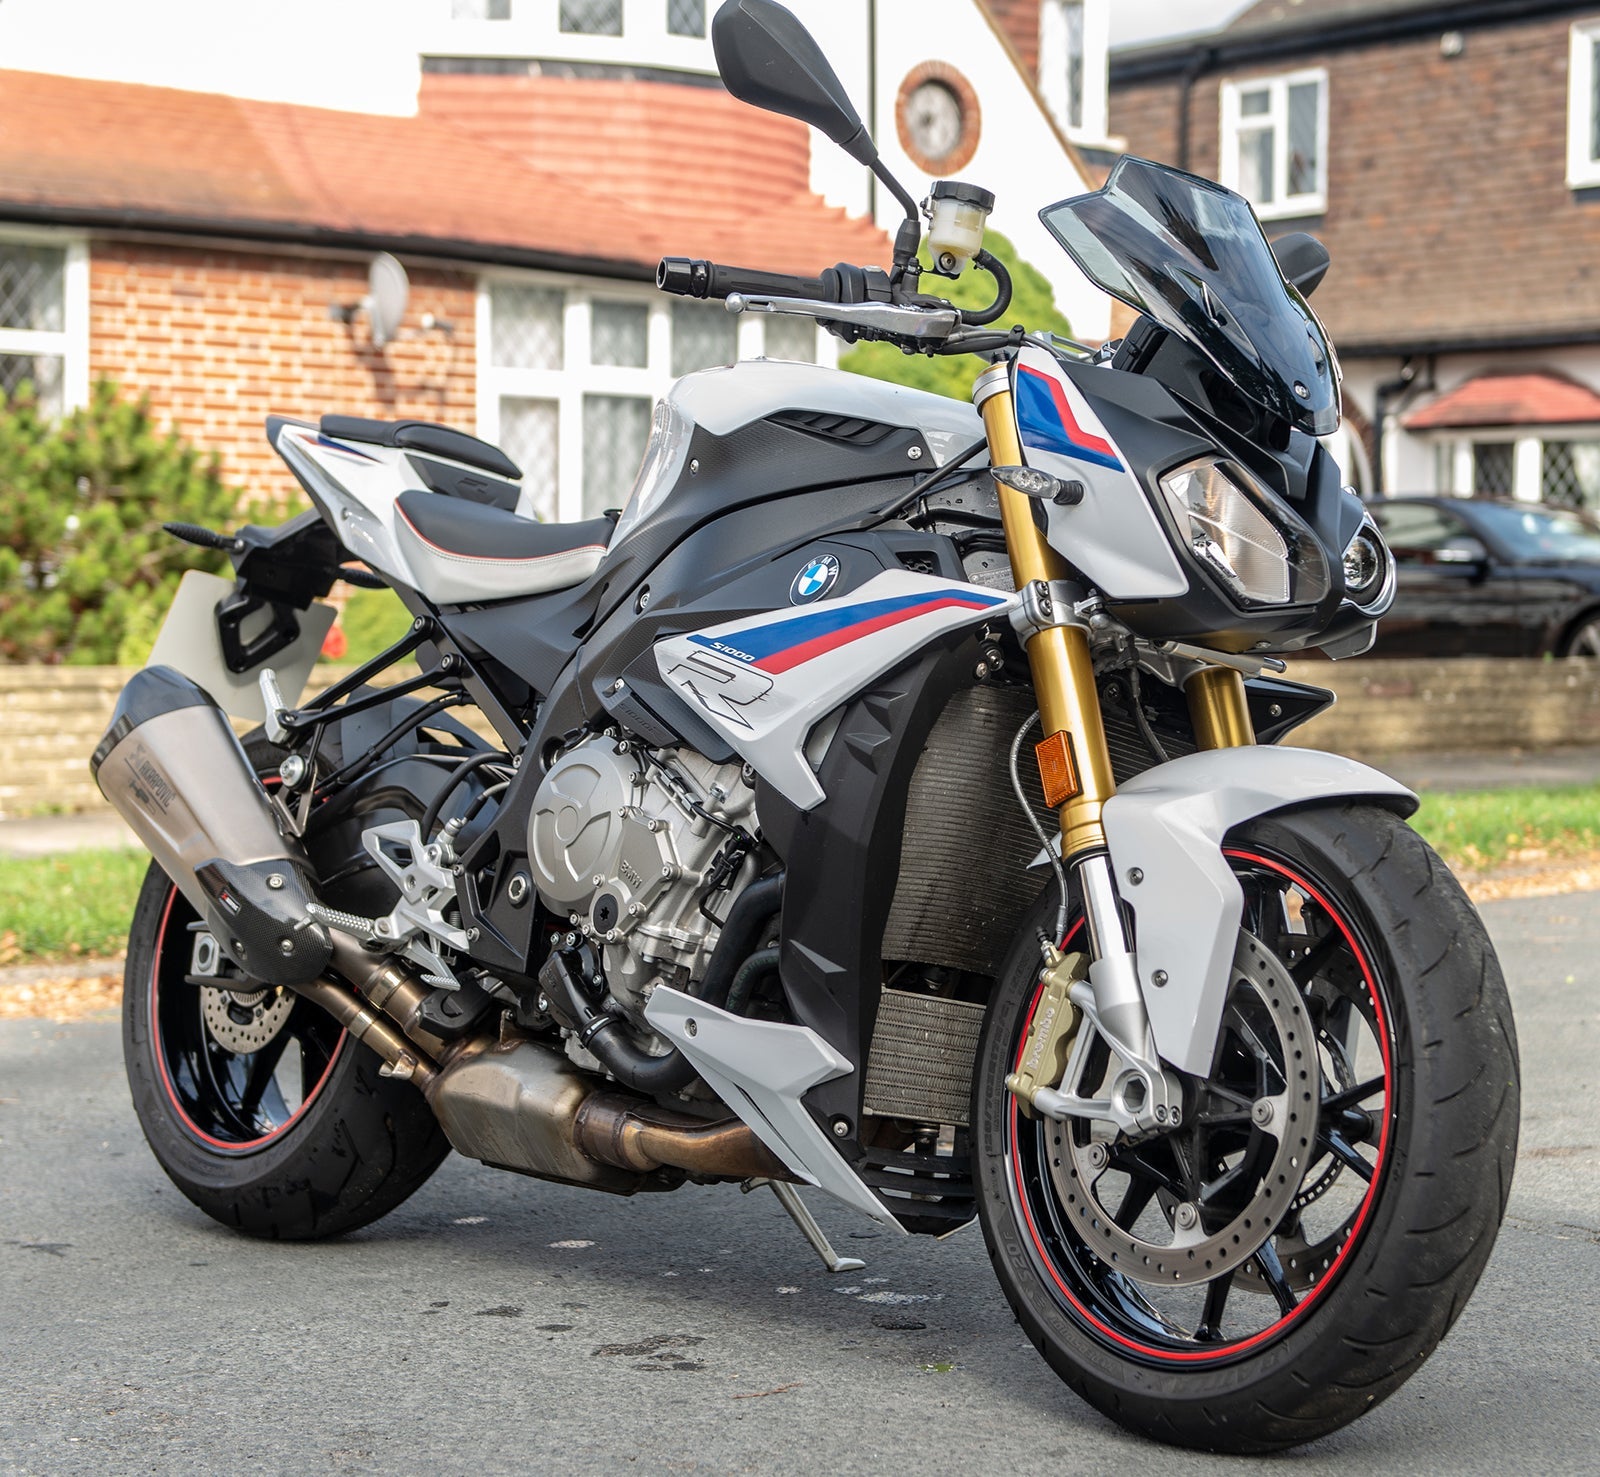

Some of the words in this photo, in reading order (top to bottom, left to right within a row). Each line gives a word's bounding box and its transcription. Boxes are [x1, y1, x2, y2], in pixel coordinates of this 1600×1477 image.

[807, 556, 838, 576] BMW
[709, 641, 757, 662] S1000
[620, 859, 643, 889] BMW
[1026, 1006, 1055, 1071] brembo
[1003, 1230, 1036, 1286] S20F
